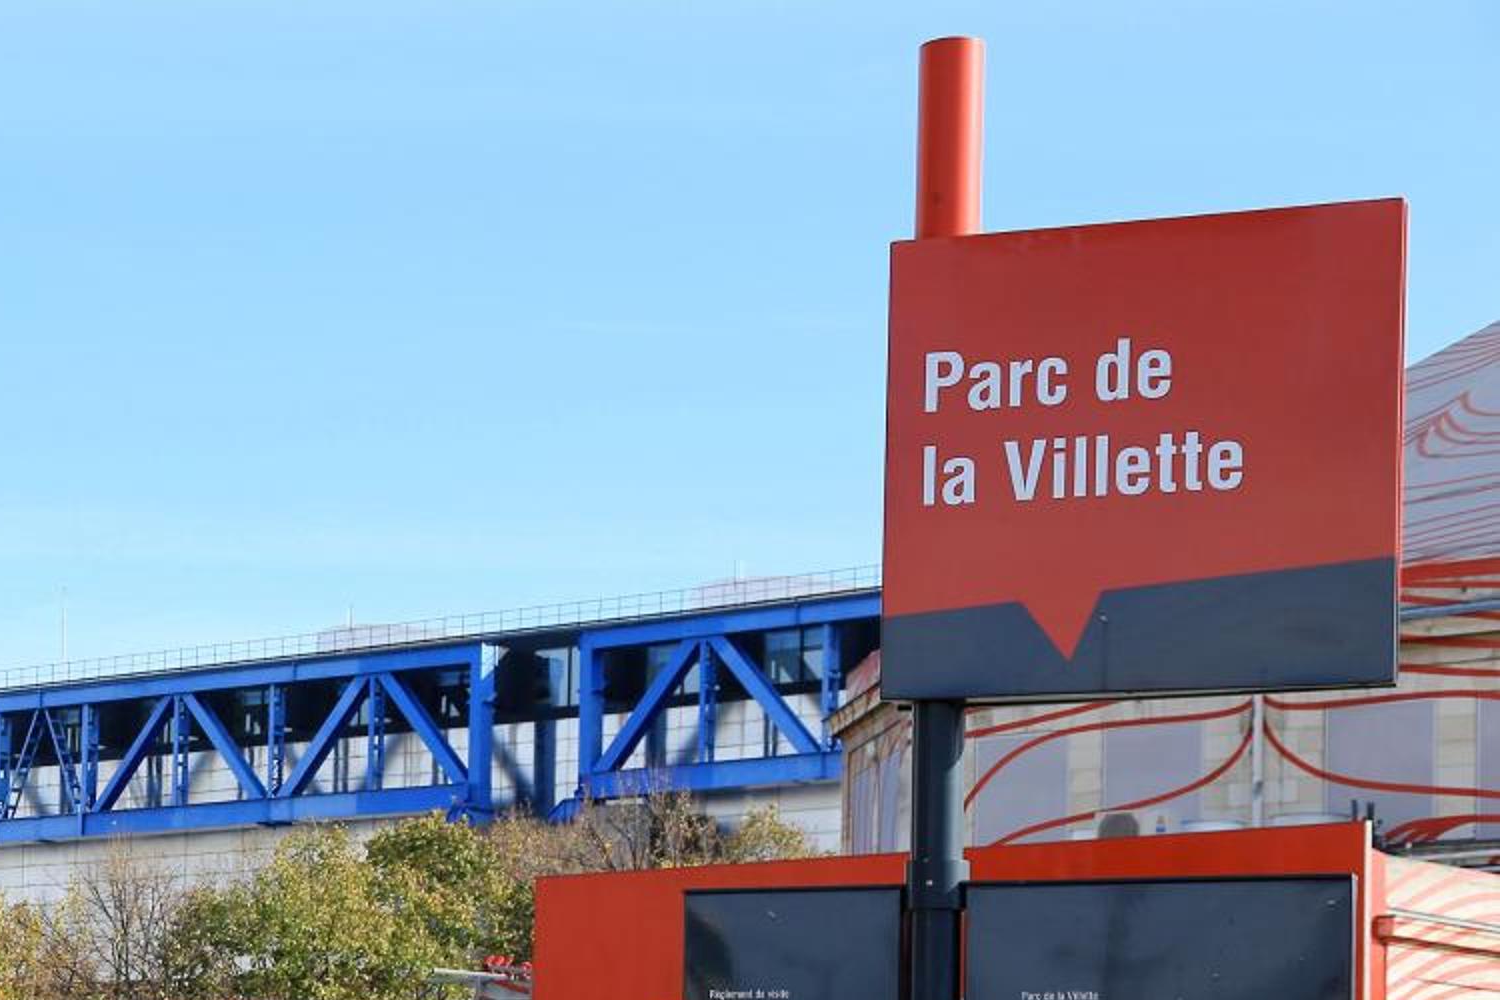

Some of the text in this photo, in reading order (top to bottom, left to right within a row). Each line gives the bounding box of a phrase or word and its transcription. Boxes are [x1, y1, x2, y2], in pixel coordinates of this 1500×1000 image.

[924, 337, 1173, 413] Parc de
[922, 431, 1244, 506] la Villette
[1021, 991, 1042, 1000] Parc
